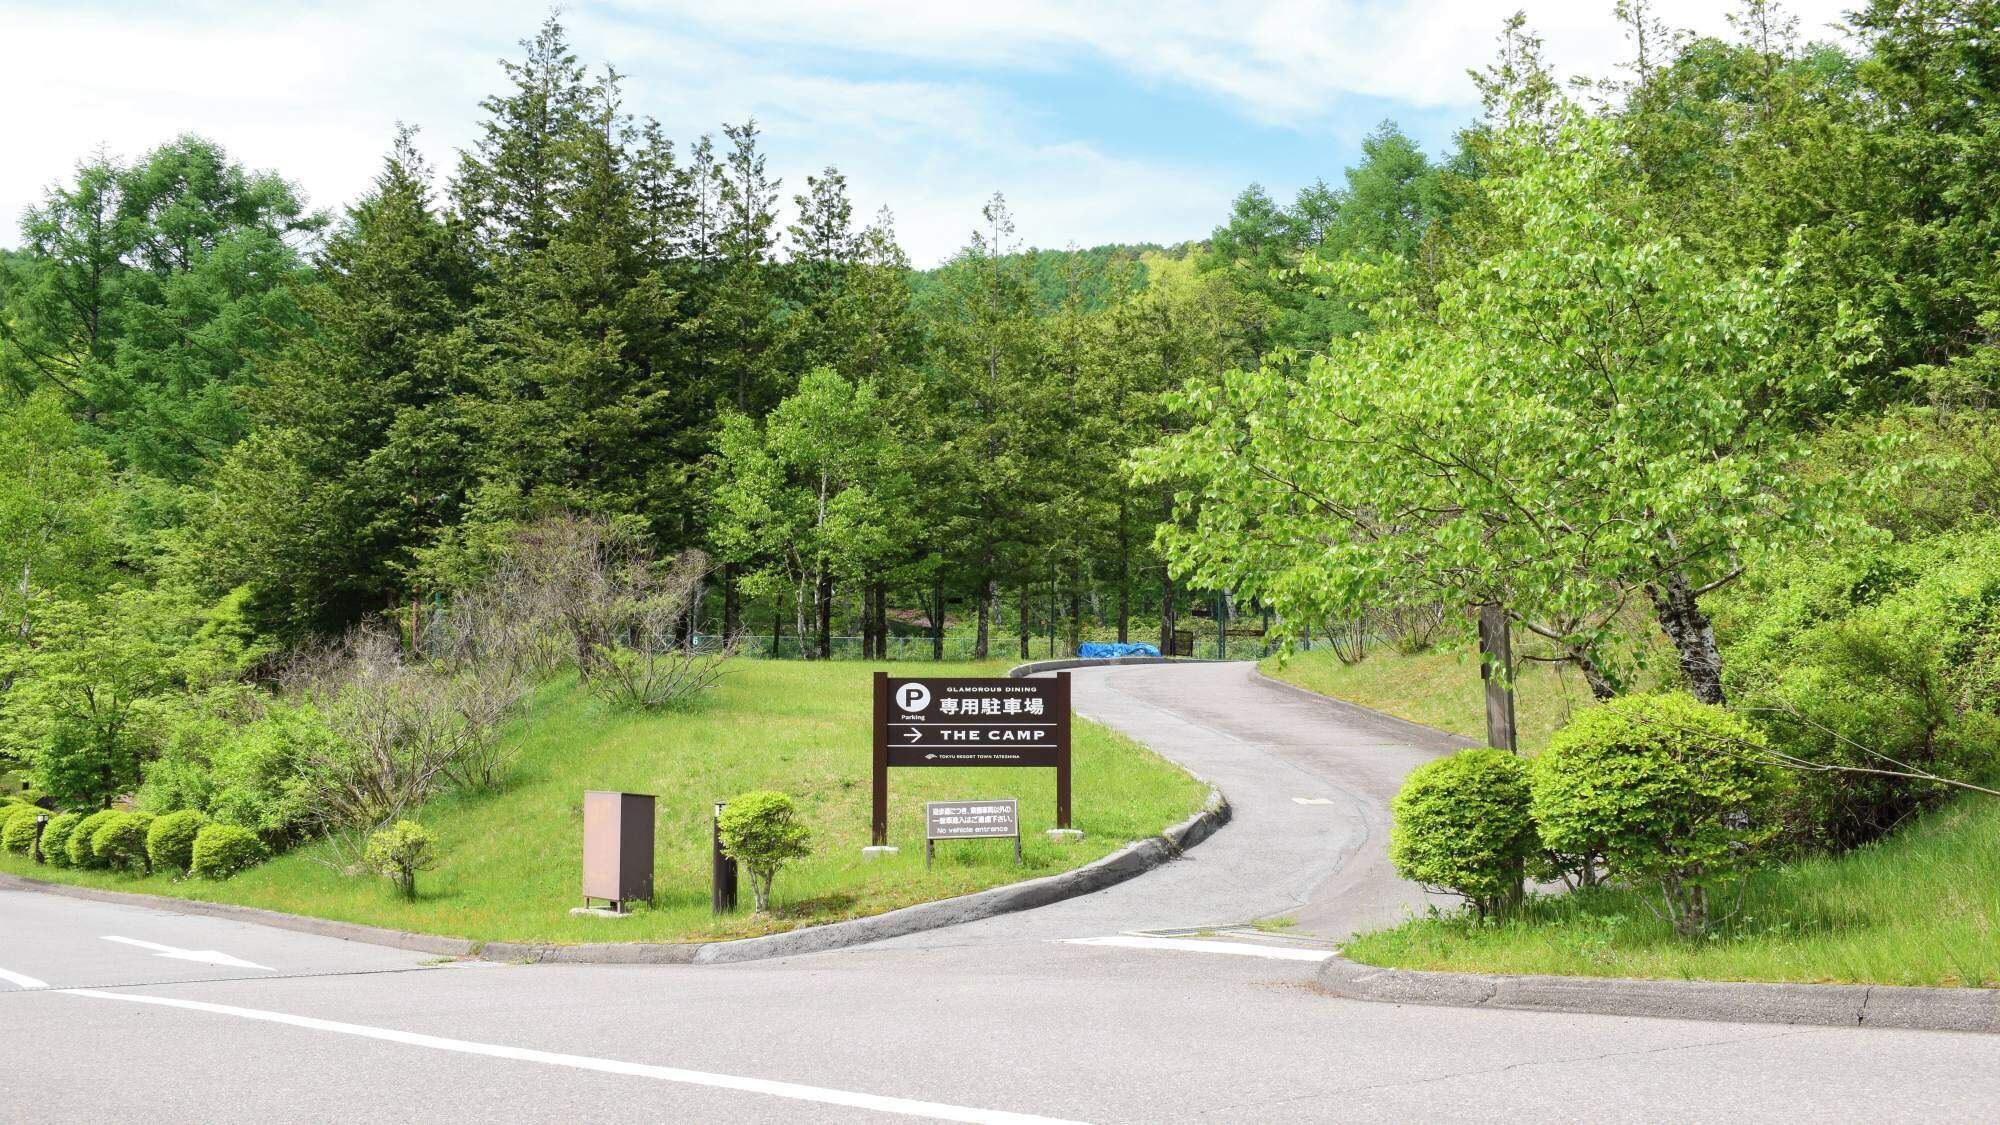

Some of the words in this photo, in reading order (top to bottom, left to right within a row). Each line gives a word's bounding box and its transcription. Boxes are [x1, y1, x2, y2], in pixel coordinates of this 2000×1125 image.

[906, 688, 924, 707] P
[939, 697, 1044, 716] 専用駐車場
[940, 730, 980, 740] THE
[988, 730, 1045, 740] CAMP
